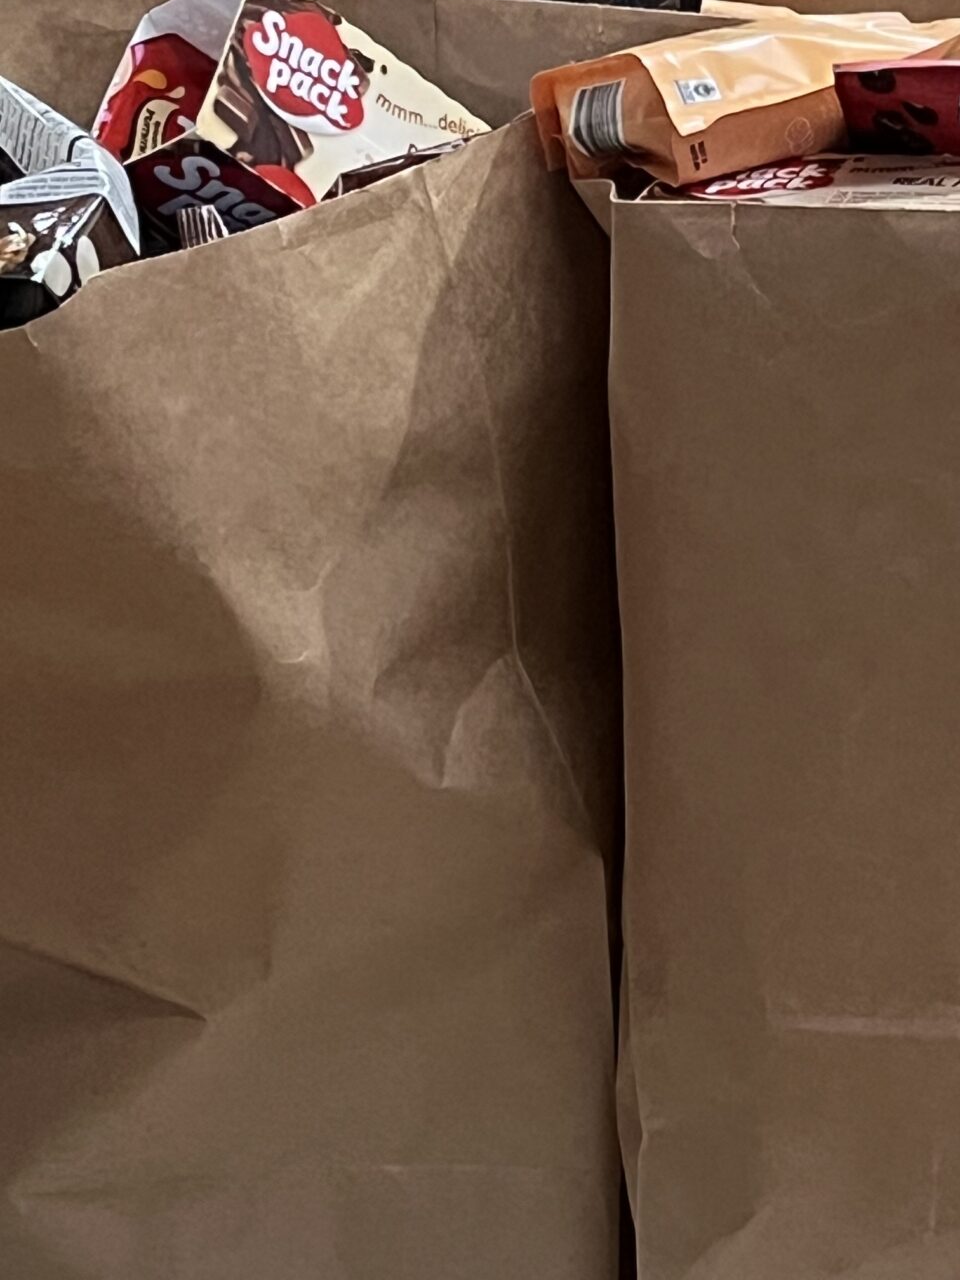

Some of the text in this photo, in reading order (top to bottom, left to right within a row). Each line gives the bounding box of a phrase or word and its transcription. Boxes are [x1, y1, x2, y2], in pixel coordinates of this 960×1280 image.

[251, 9, 361, 100] Snack
[153, 156, 278, 222] Sna
[892, 176, 946, 187] REAL
